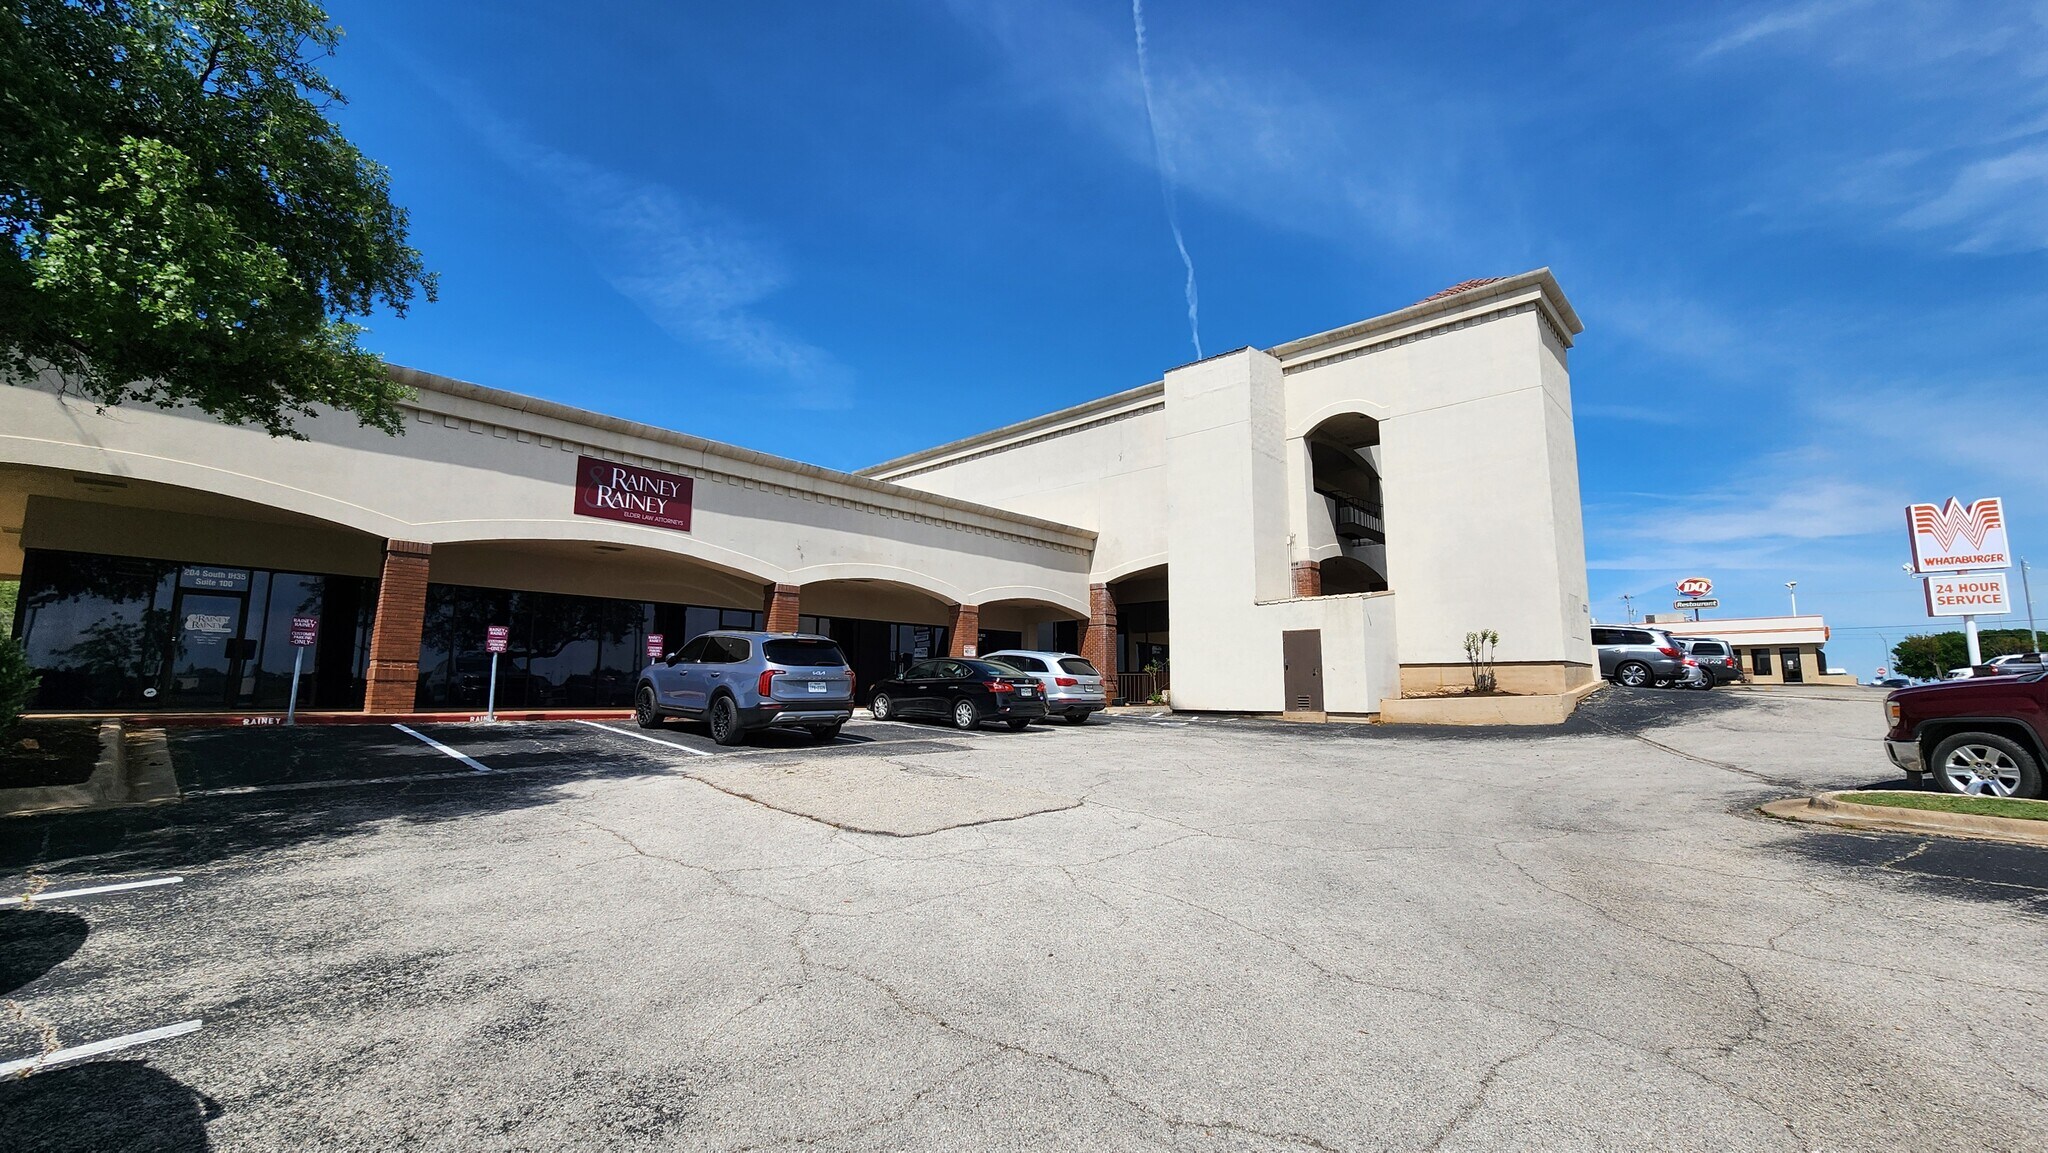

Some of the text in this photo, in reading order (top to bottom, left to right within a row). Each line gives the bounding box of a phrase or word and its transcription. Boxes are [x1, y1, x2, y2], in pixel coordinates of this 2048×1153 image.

[611, 467, 681, 498] RAINEY
[596, 484, 668, 514] RAINEY
[624, 511, 641, 519] ELDER
[654, 516, 684, 526] ATTORNEYS
[1924, 553, 2005, 567] WHATABURGER
[202, 570, 226, 578] South
[195, 578, 217, 586] Suite
[1683, 582, 1708, 593] DQ
[1936, 582, 2000, 594] 24 HOUR
[1677, 600, 1717, 608] Restaurant
[1937, 594, 2002, 605] SERVICE
[242, 717, 281, 726] RAINEY
[469, 715, 498, 723] RAINY
